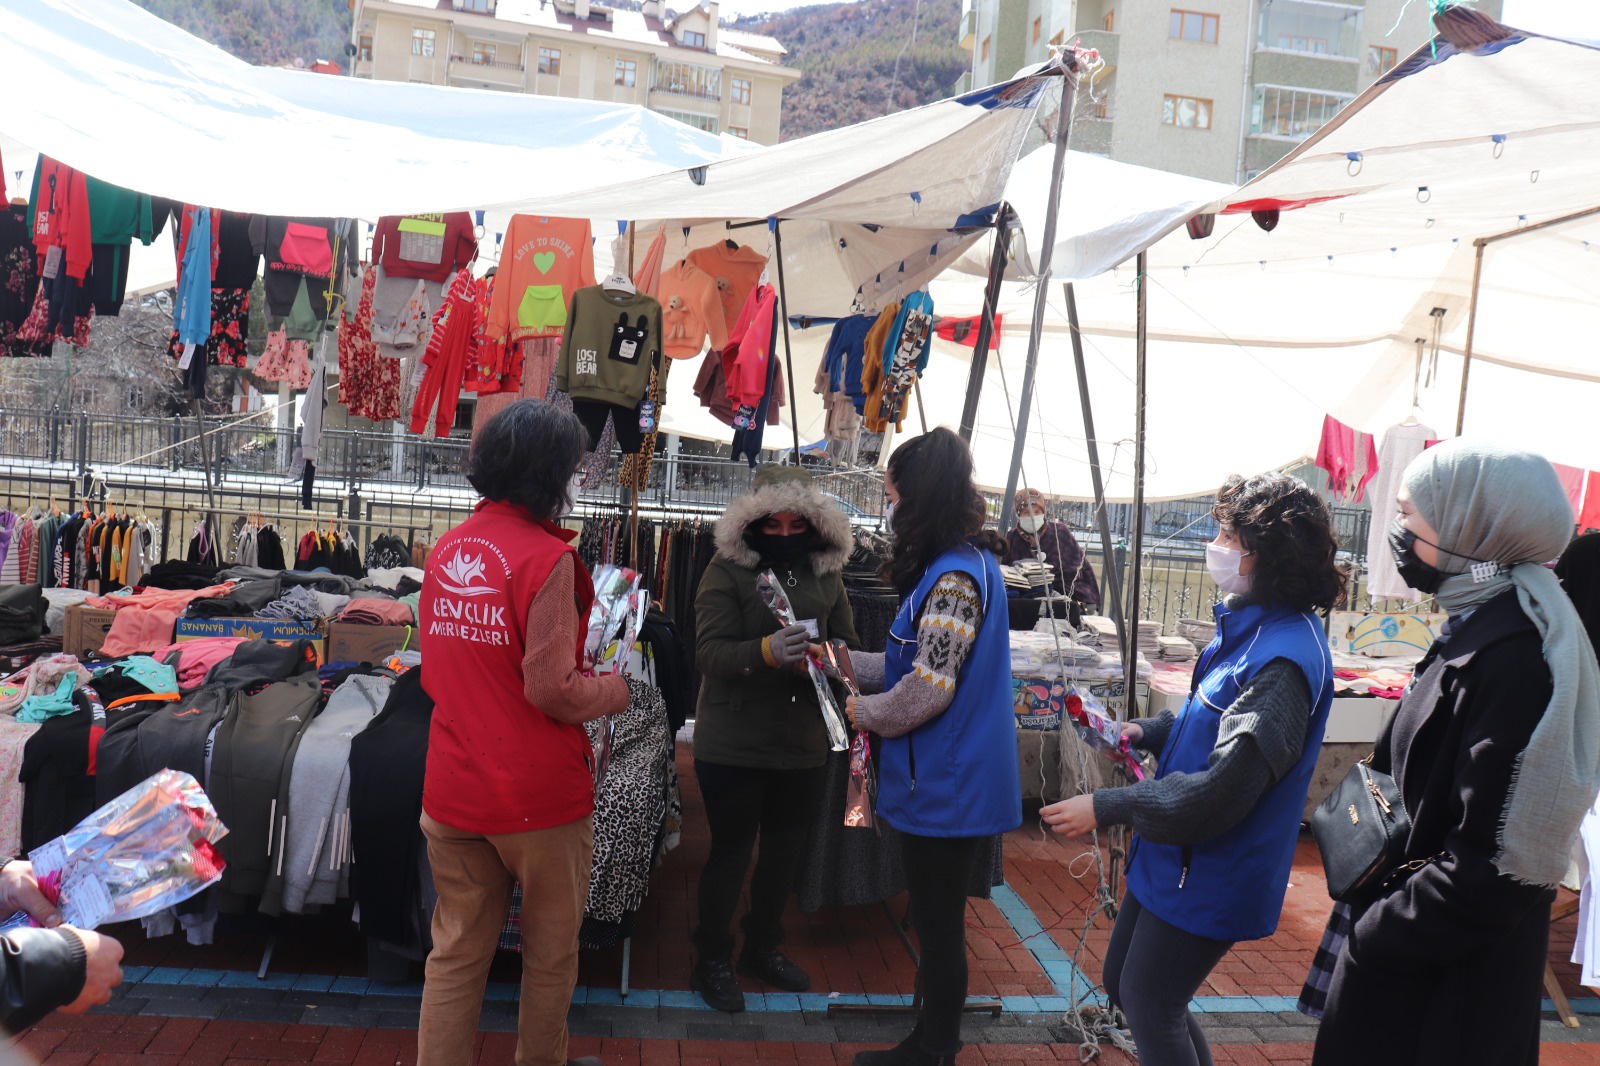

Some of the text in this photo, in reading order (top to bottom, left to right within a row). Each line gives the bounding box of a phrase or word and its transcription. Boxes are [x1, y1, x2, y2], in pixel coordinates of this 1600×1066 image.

[514, 237, 575, 261] LOVE TO SHINE
[577, 349, 597, 362] LOST
[576, 361, 597, 376] BEAR
[473, 537, 490, 546] SPOR
[433, 597, 506, 627] GENÇLİK
[181, 622, 224, 633] BANANAS
[429, 621, 510, 646] MERKEZLERİ
